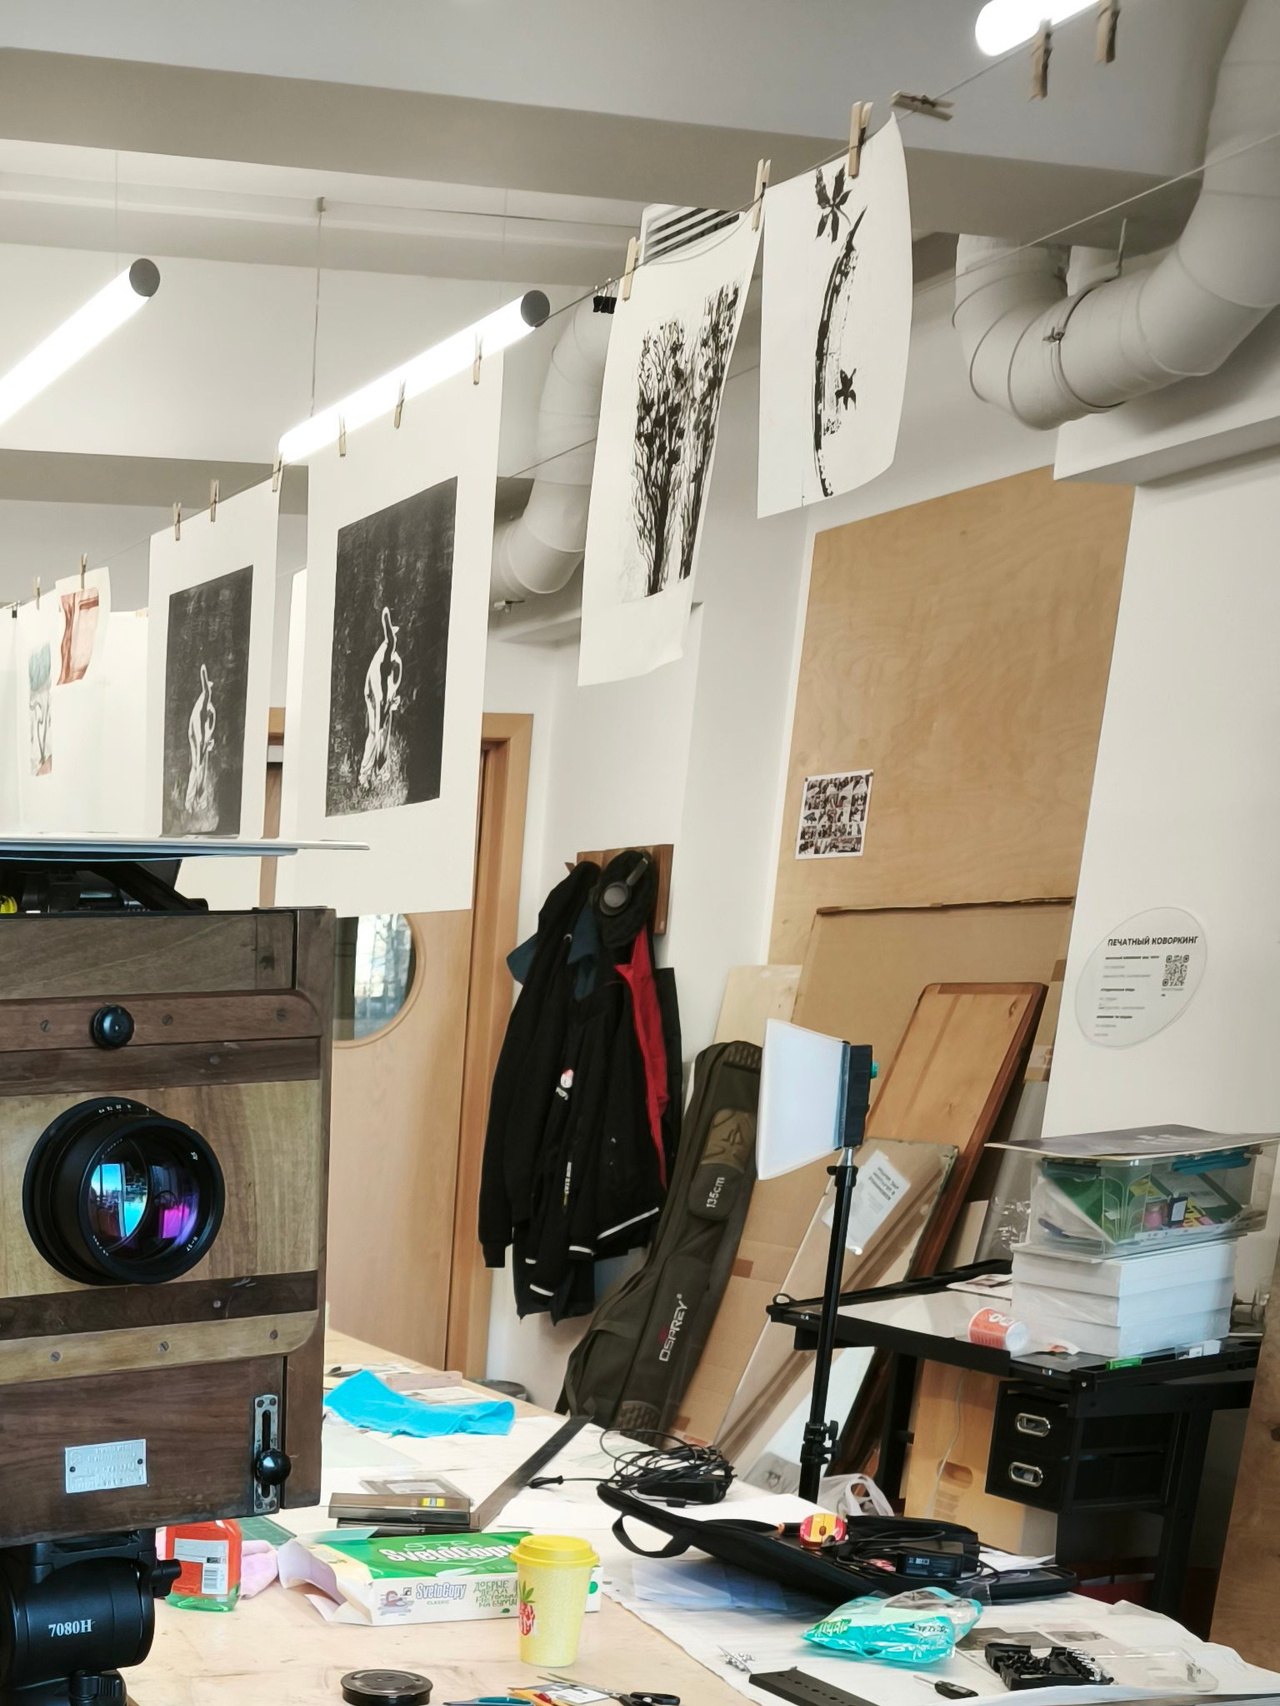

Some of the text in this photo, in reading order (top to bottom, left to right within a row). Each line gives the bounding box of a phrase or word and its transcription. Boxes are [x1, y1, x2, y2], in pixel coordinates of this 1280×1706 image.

[1107, 935, 1199, 946] ПЕЧАТНЫЙ КОВОРКИНГ
[706, 1176, 726, 1208] 135cm
[659, 1300, 688, 1362] OSPREY
[378, 1544, 514, 1562] SvetoCopy
[415, 1582, 468, 1600] SvetoCopy
[48, 1619, 93, 1638] 7080H
